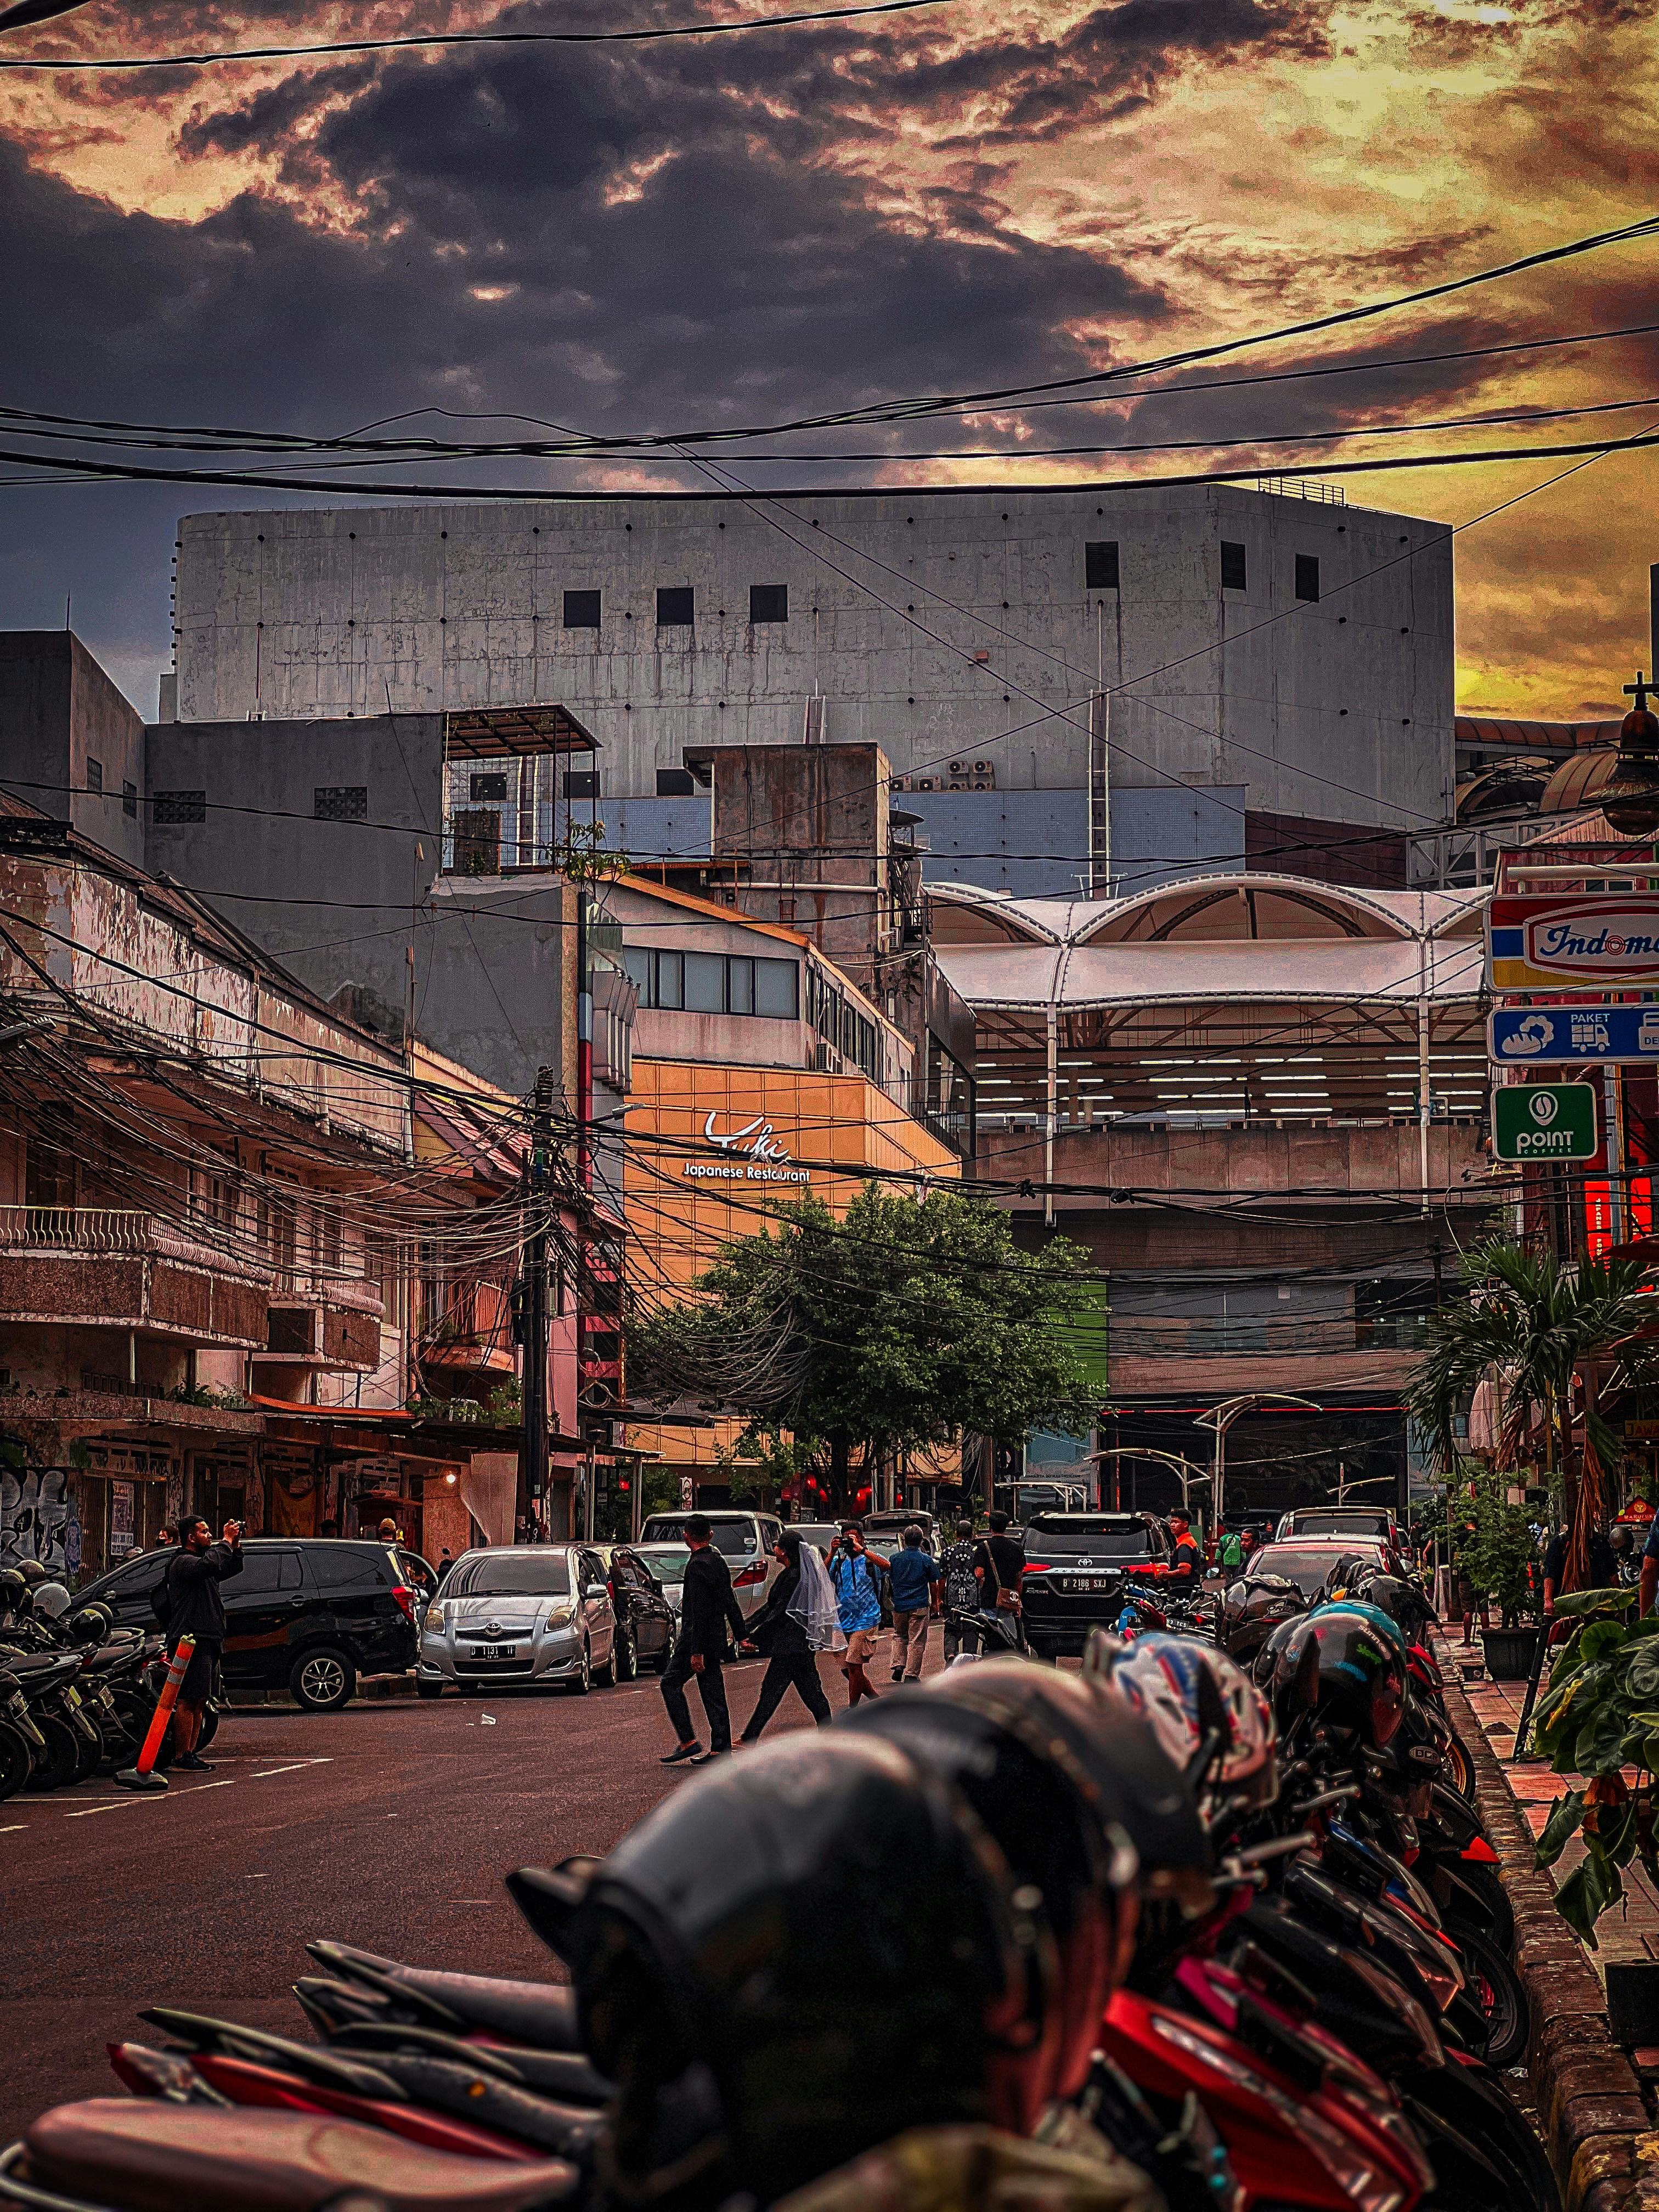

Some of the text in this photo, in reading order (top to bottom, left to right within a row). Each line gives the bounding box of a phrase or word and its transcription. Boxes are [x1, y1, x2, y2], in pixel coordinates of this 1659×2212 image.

[1540, 925, 1659, 956] Indom
[1571, 1013, 1611, 1023] PAKET
[1644, 1036, 1659, 1045] DE
[684, 1162, 811, 1182] Japanese Restaurant
[1063, 1578, 1068, 1587] B
[1093, 1579, 1106, 1588] SXJ
[471, 1647, 476, 1655] D
[483, 1646, 498, 1655] 1131
